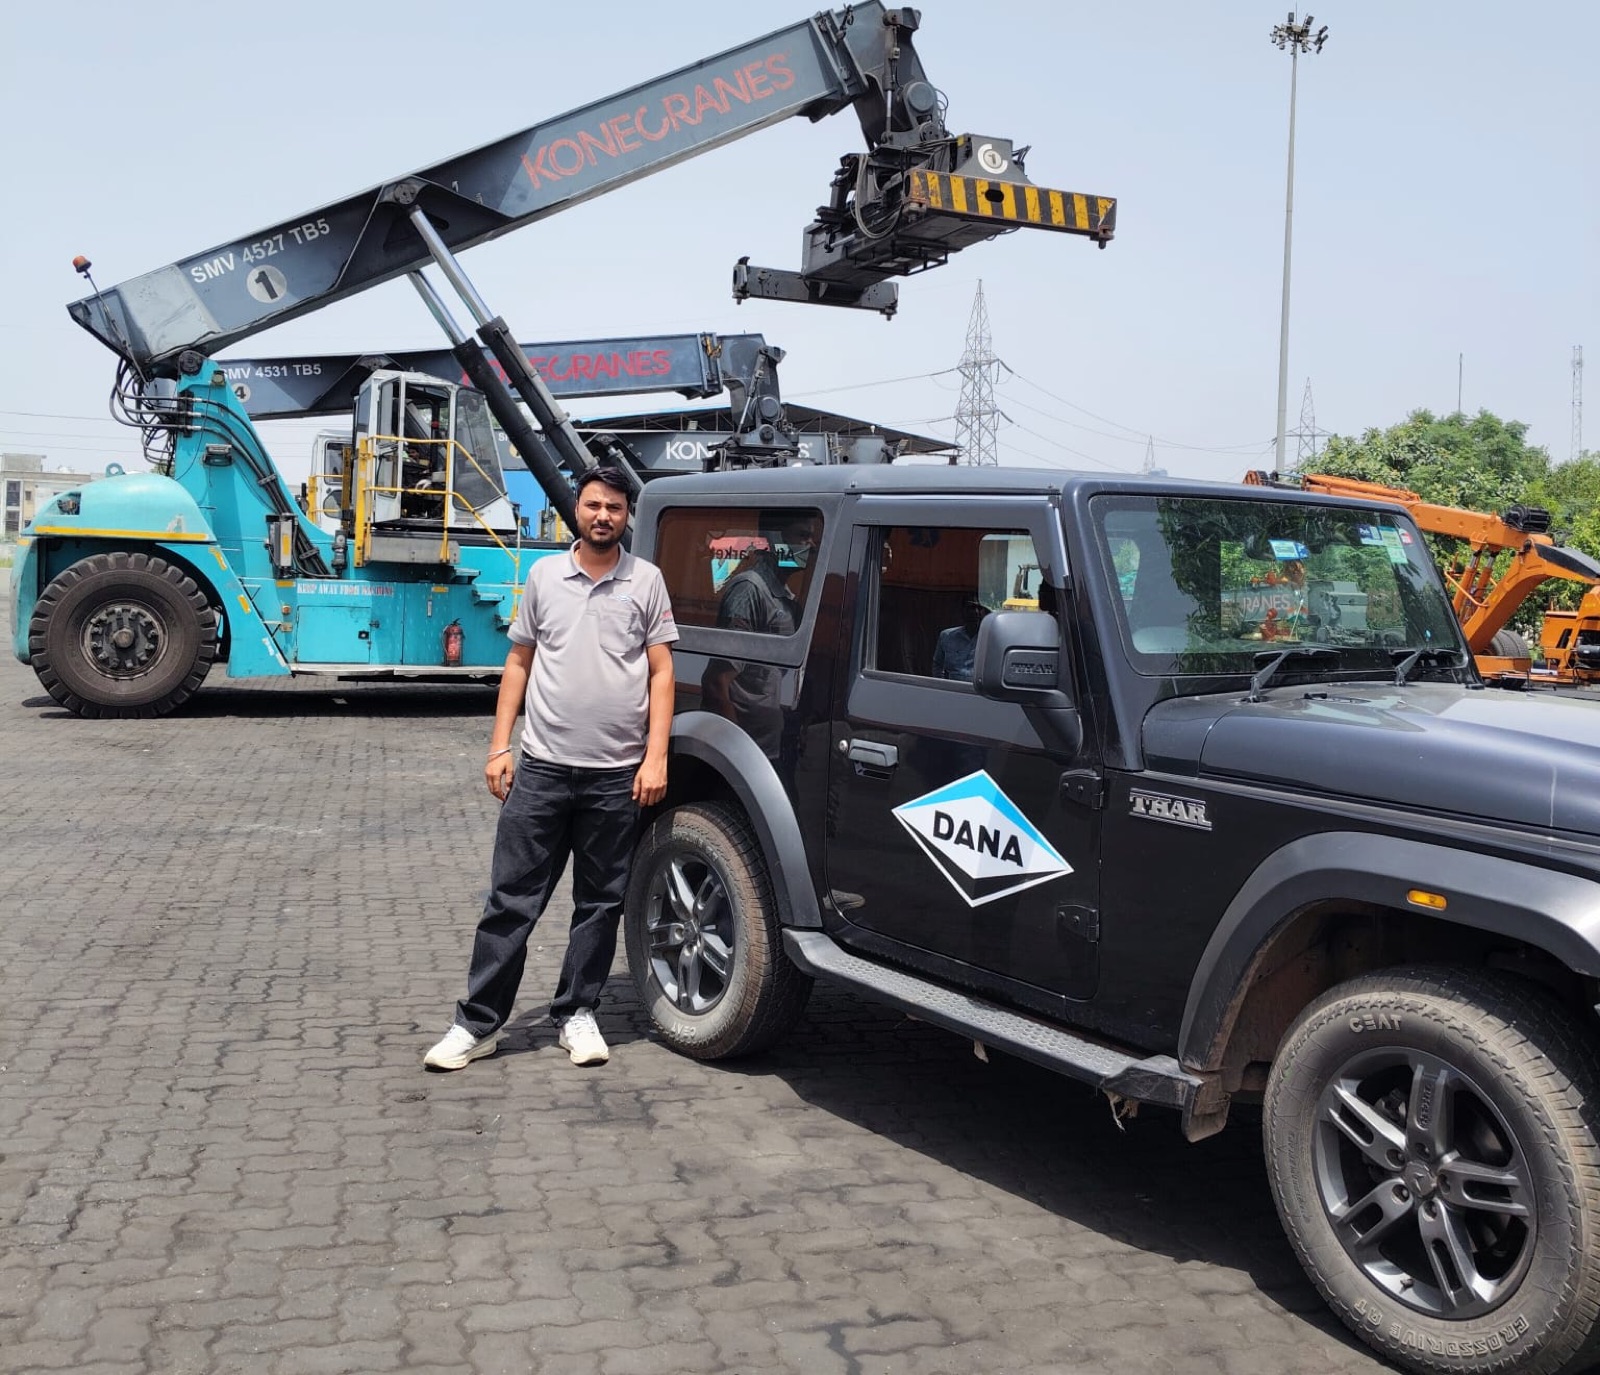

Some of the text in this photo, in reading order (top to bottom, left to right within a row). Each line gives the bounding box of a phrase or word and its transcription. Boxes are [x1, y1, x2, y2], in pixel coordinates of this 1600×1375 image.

[520, 51, 796, 189] KONECRANES
[190, 218, 330, 283] SMV 4527 TB5
[254, 270, 278, 300] 1
[255, 365, 288, 378] 4531
[292, 363, 322, 376] TB5
[234, 385, 247, 400] 4
[1130, 793, 1212, 827] THAR
[932, 809, 1024, 868] DANA
[1350, 1014, 1402, 1033] CEAT
